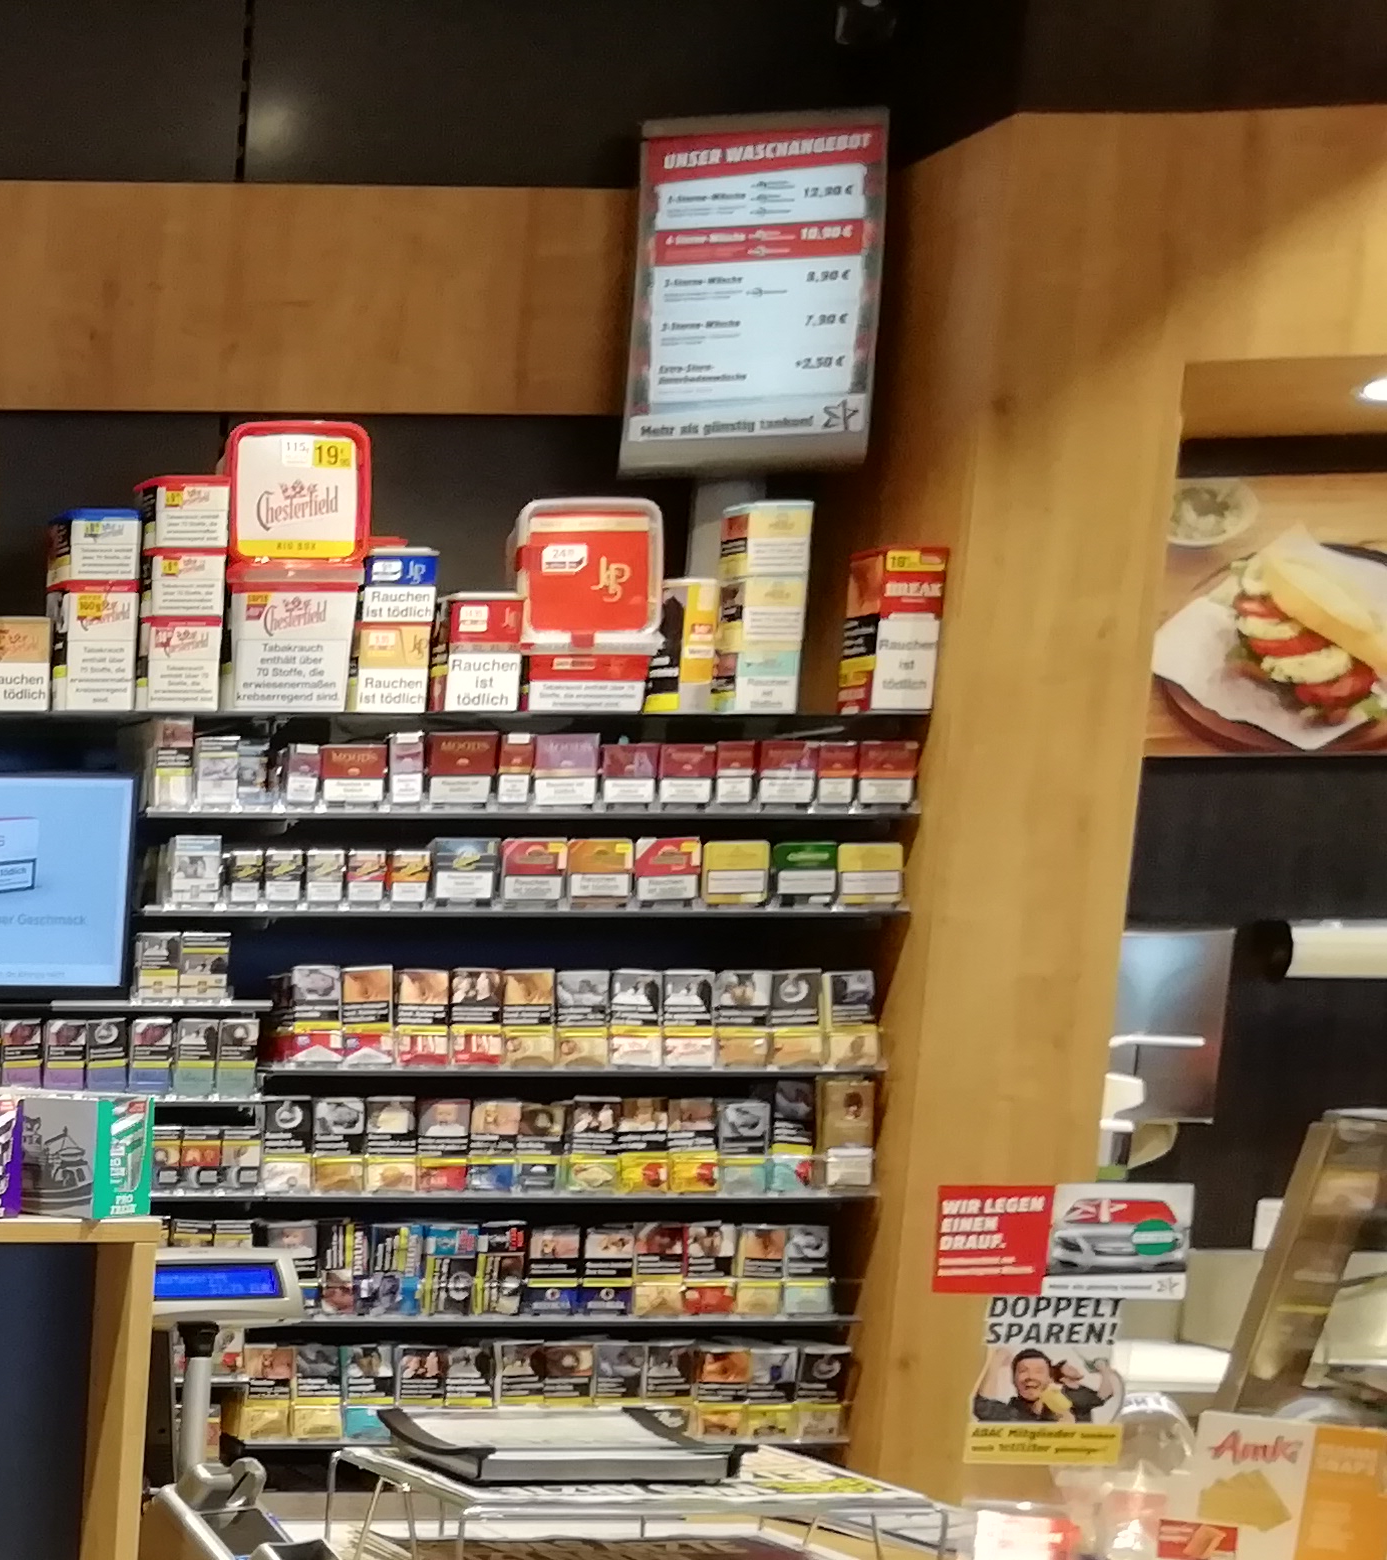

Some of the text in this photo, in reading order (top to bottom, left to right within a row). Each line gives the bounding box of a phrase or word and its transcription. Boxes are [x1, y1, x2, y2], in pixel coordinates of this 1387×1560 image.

[663, 134, 872, 169] UNSER WASCHANGEBOT
[315, 445, 338, 464] 19
[257, 486, 338, 531] Chesterfield
[264, 601, 326, 636] Chesterfield
[451, 660, 517, 671] Rauchen
[476, 677, 493, 688] ist
[457, 693, 508, 706] tödlich
[942, 1196, 1045, 1215] WIR LEGEN
[941, 1217, 999, 1232] EINEN
[989, 1297, 1124, 1317] DOPPELT
[986, 1323, 1117, 1344] SPAREN!
